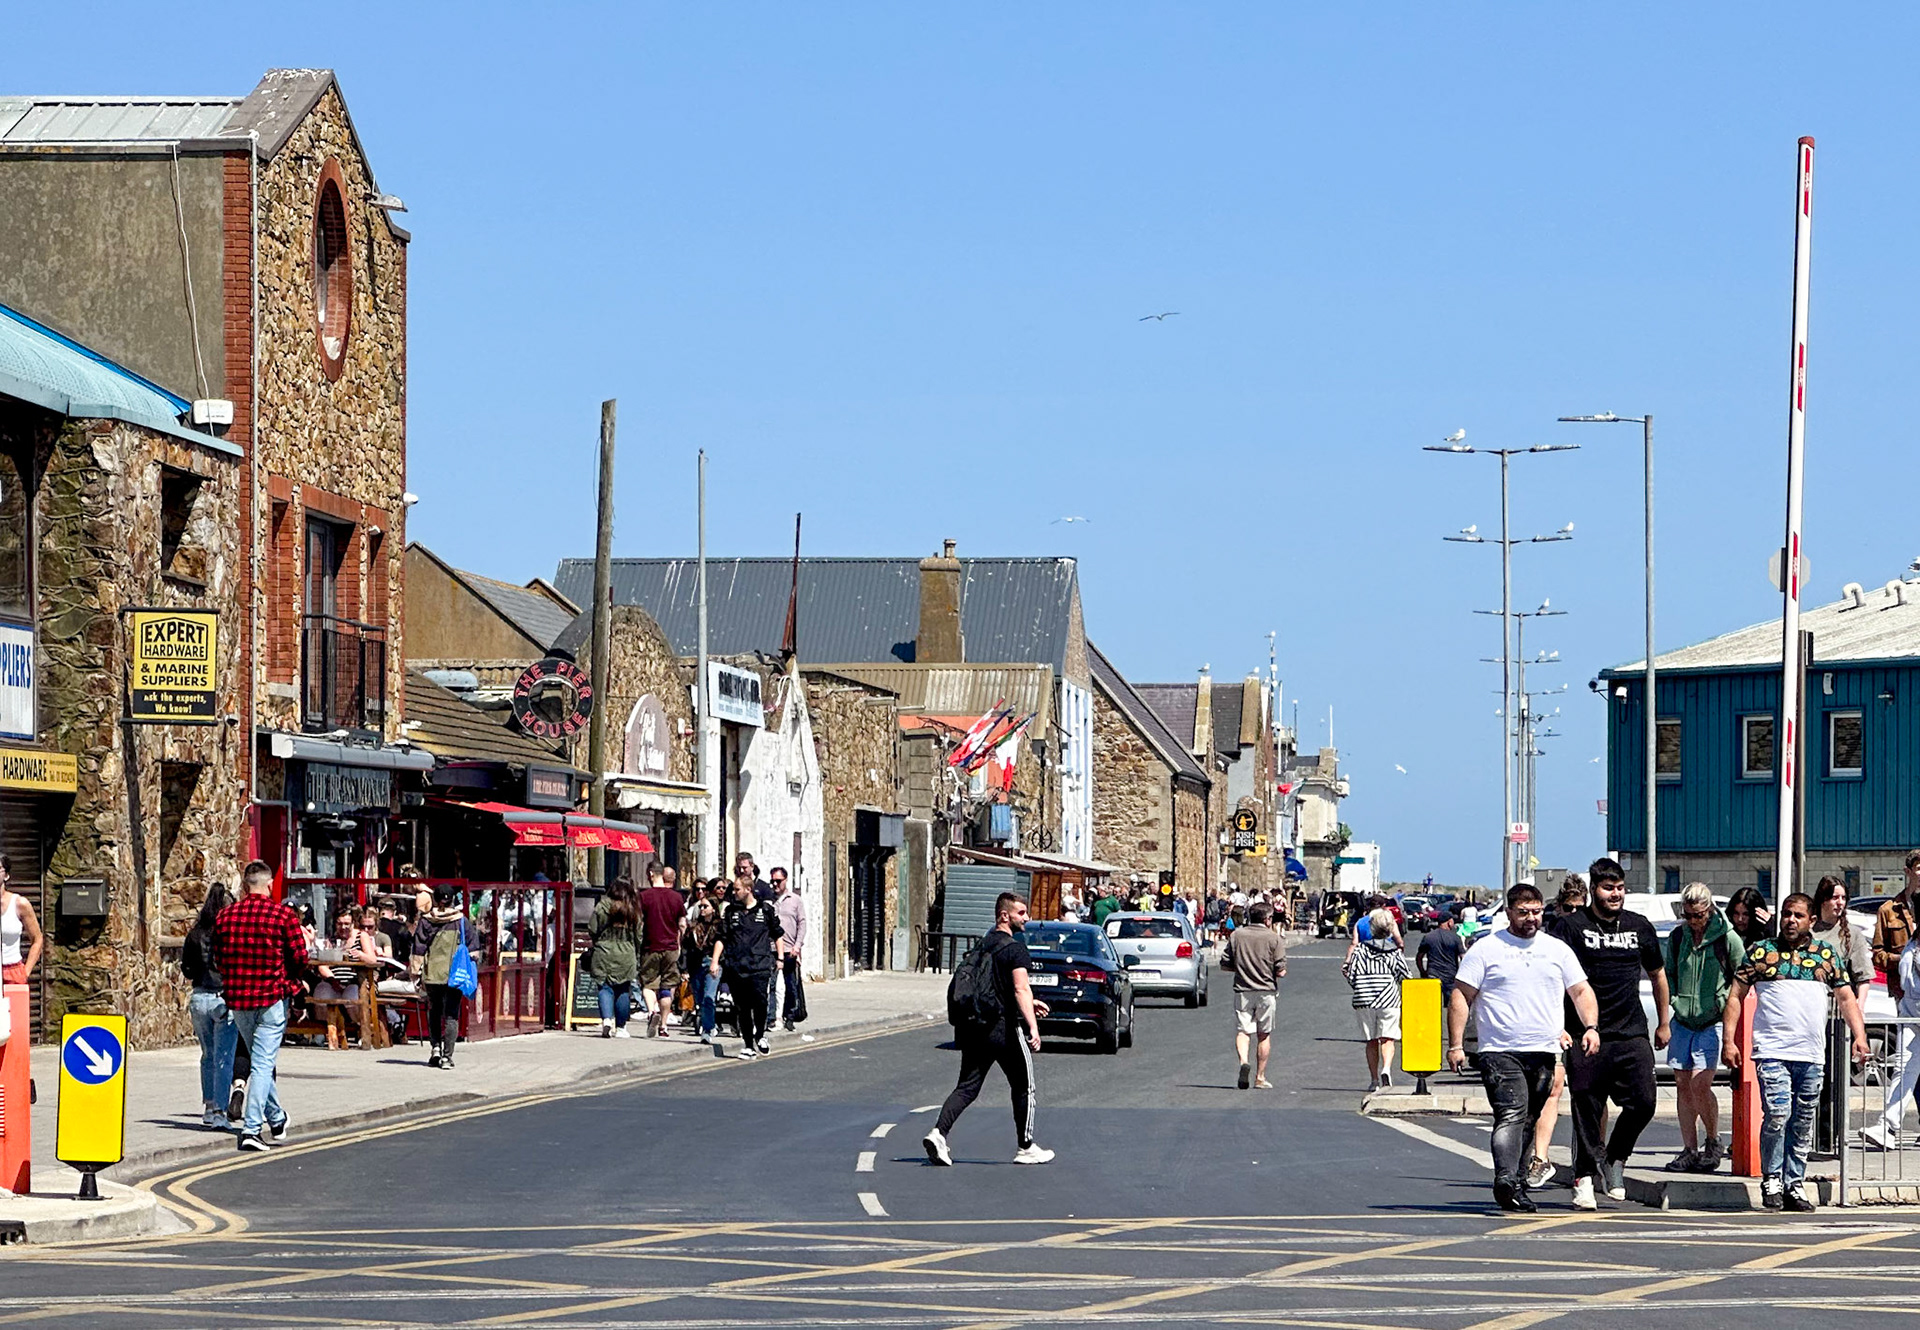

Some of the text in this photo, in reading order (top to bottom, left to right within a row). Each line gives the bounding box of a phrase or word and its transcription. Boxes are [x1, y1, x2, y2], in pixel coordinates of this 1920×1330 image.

[145, 621, 205, 644] EXPERT
[144, 644, 205, 658] HARDWARE
[0, 641, 31, 690] PLIERS
[140, 662, 209, 675] & MARINE
[141, 675, 208, 687] SUPPLIERS
[515, 661, 592, 700] THE PIER
[160, 691, 174, 702] the
[176, 694, 207, 705] experts,
[155, 704, 192, 714] We know!
[521, 711, 587, 738] HOUSE
[3, 756, 47, 782] HARDWARE
[311, 771, 327, 803] THE
[1236, 831, 1255, 839] KISH
[1236, 839, 1255, 847] FISH
